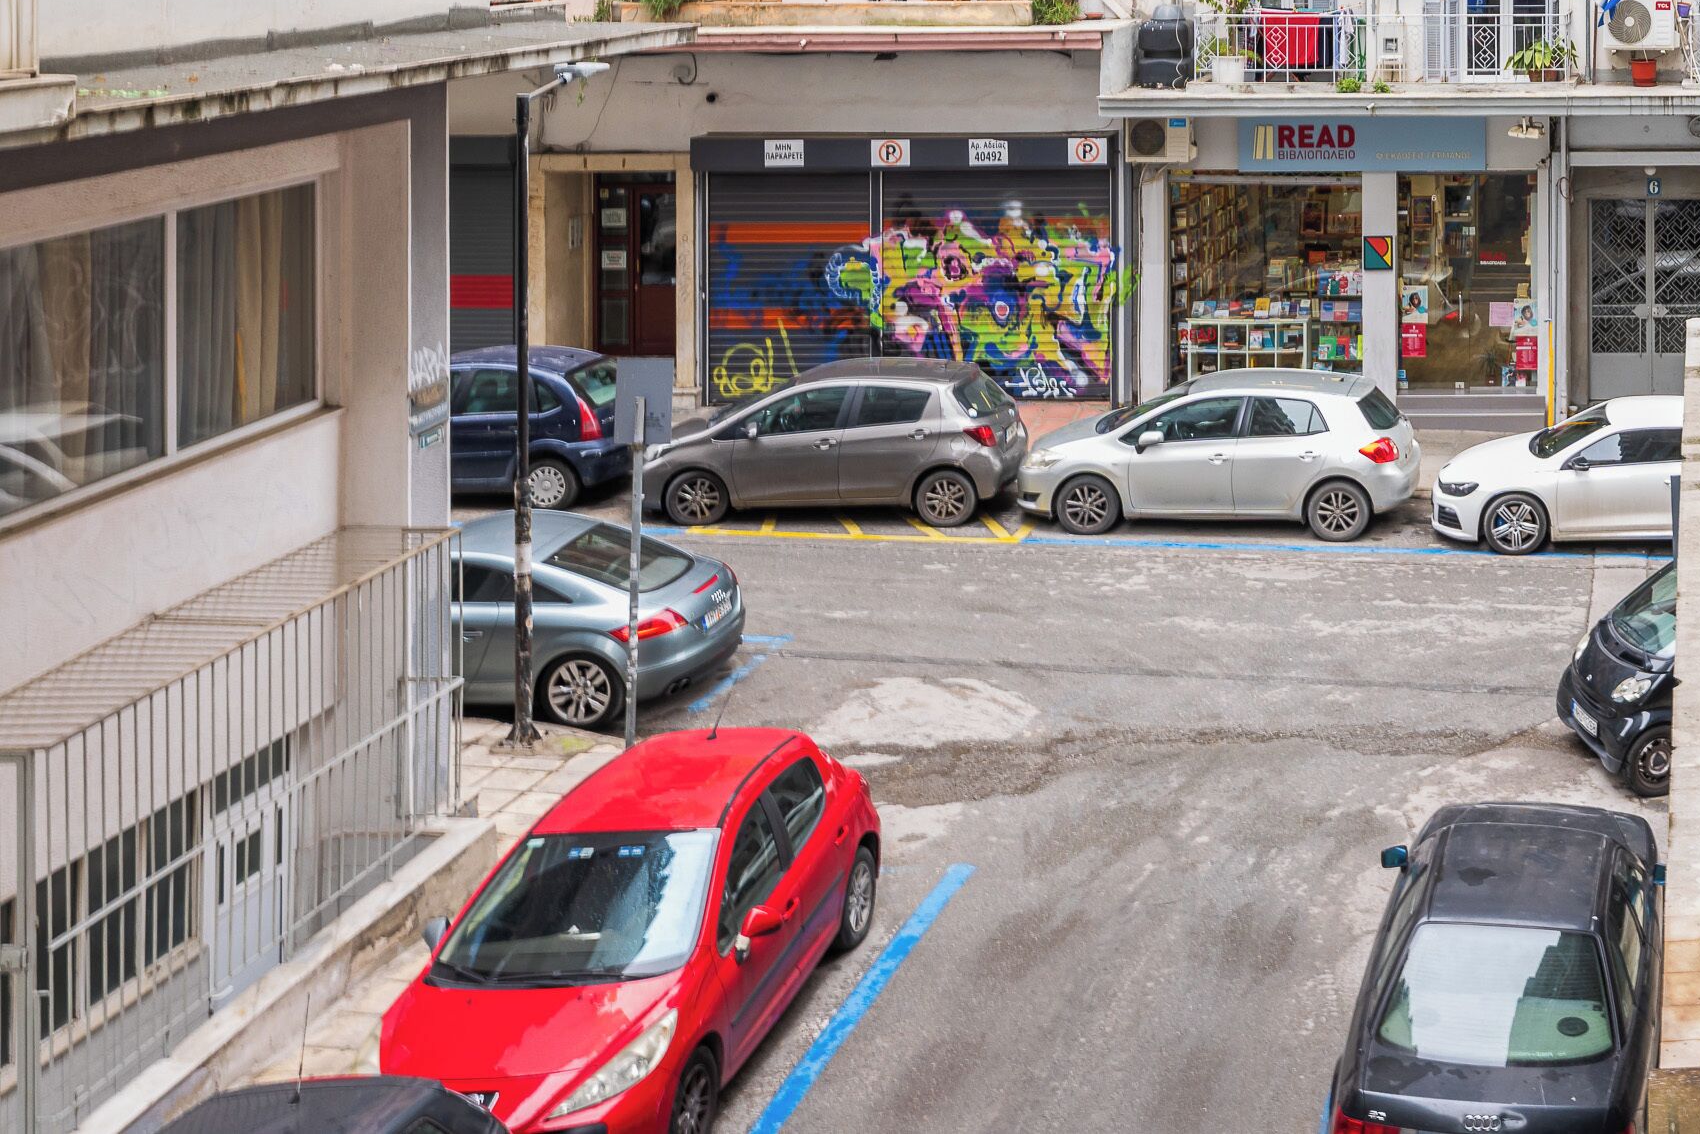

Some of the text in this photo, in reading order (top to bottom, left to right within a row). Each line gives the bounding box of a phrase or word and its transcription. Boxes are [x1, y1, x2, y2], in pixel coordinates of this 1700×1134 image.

[1278, 125, 1356, 148] READ
[775, 143, 792, 151] ΜΗΝ
[983, 140, 1006, 149] Αδείας
[765, 152, 803, 161] ΠΑΡΚΑΡΕΤΕ
[974, 151, 1003, 162] 40492
[1278, 150, 1356, 160] ΒΙΒΛΙΟΠΩΛΕΙΟ
[1649, 180, 1659, 194] 6
[1180, 327, 1217, 342] READ
